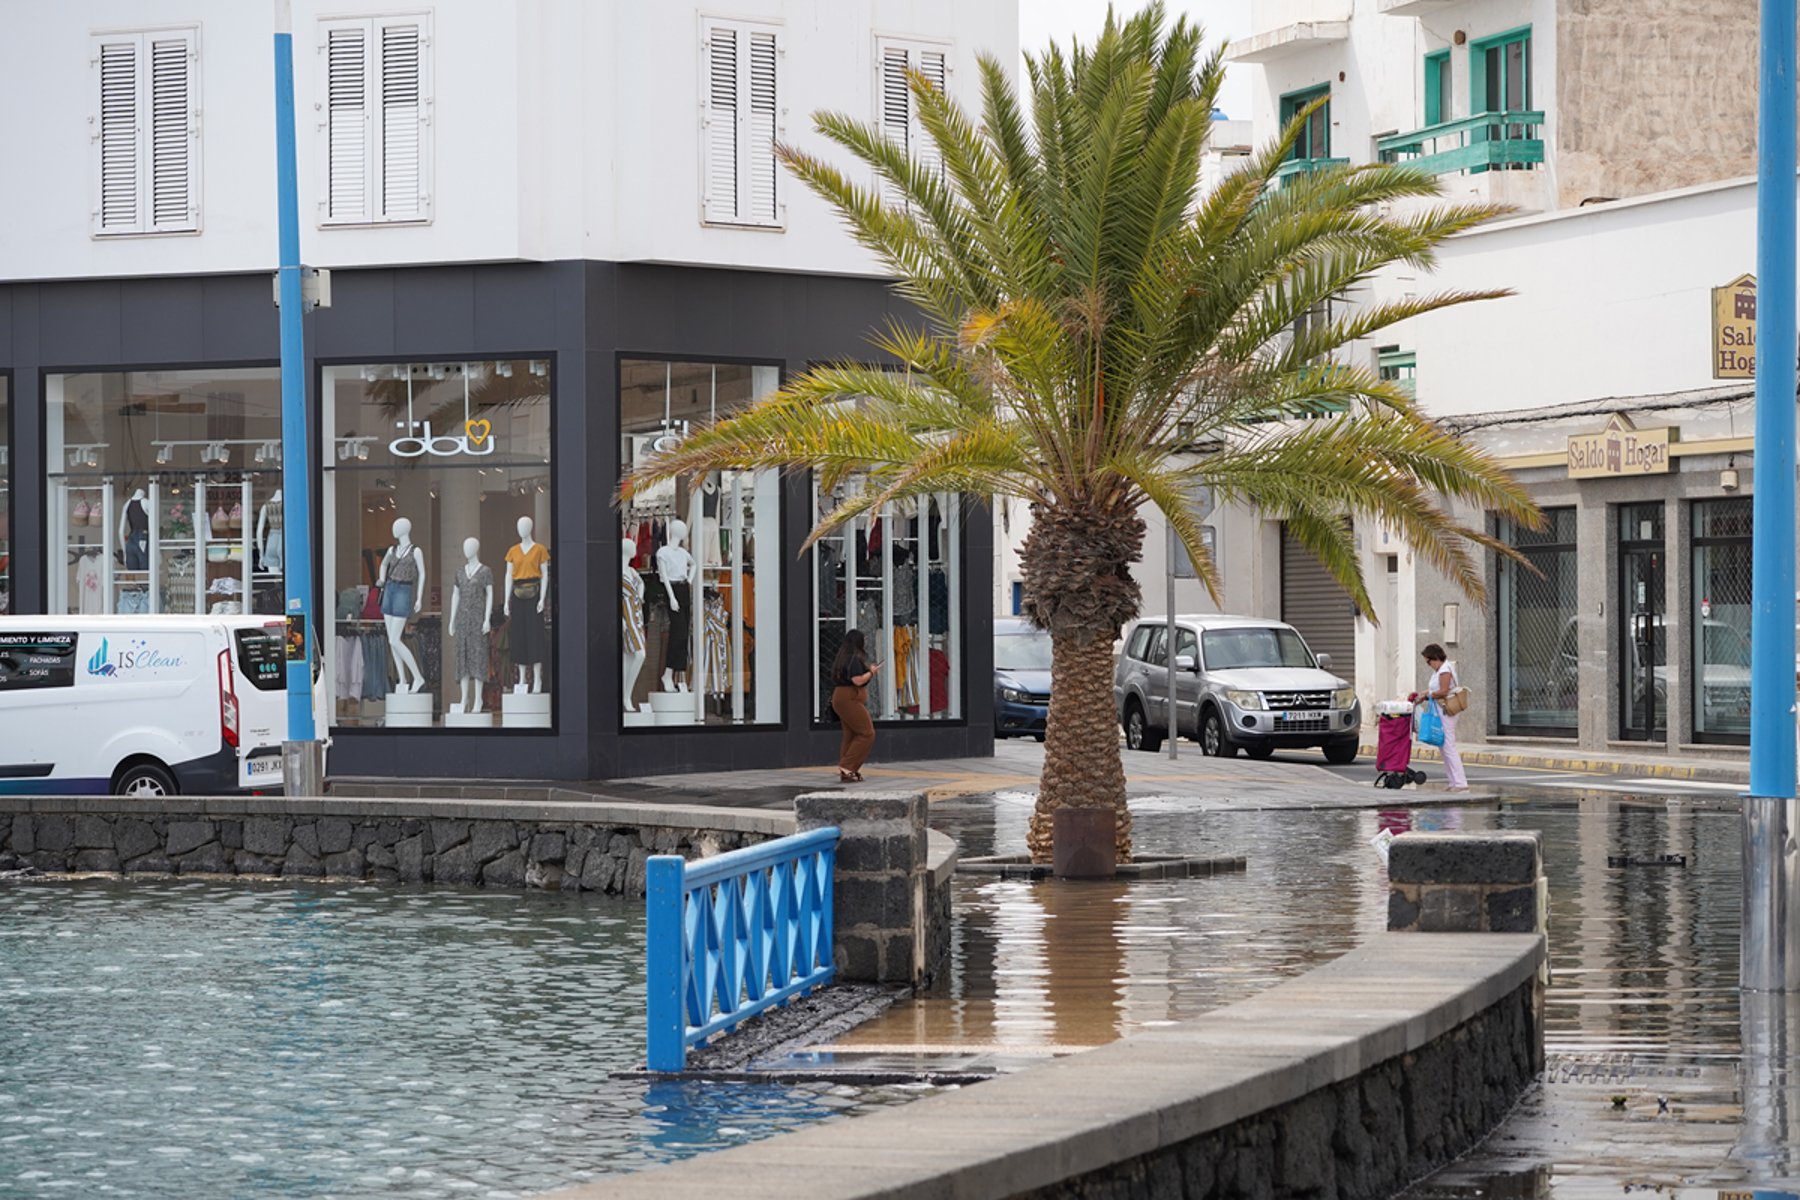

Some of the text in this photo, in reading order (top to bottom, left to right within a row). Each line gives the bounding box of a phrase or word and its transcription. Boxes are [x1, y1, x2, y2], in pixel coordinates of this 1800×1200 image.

[1722, 326, 1756, 346] Sal
[1719, 351, 1756, 374] Hog
[1570, 436, 1666, 471] Saldo Hogar
[37, 635, 71, 643] LIMPIEZA
[29, 656, 61, 664] FACHADAS
